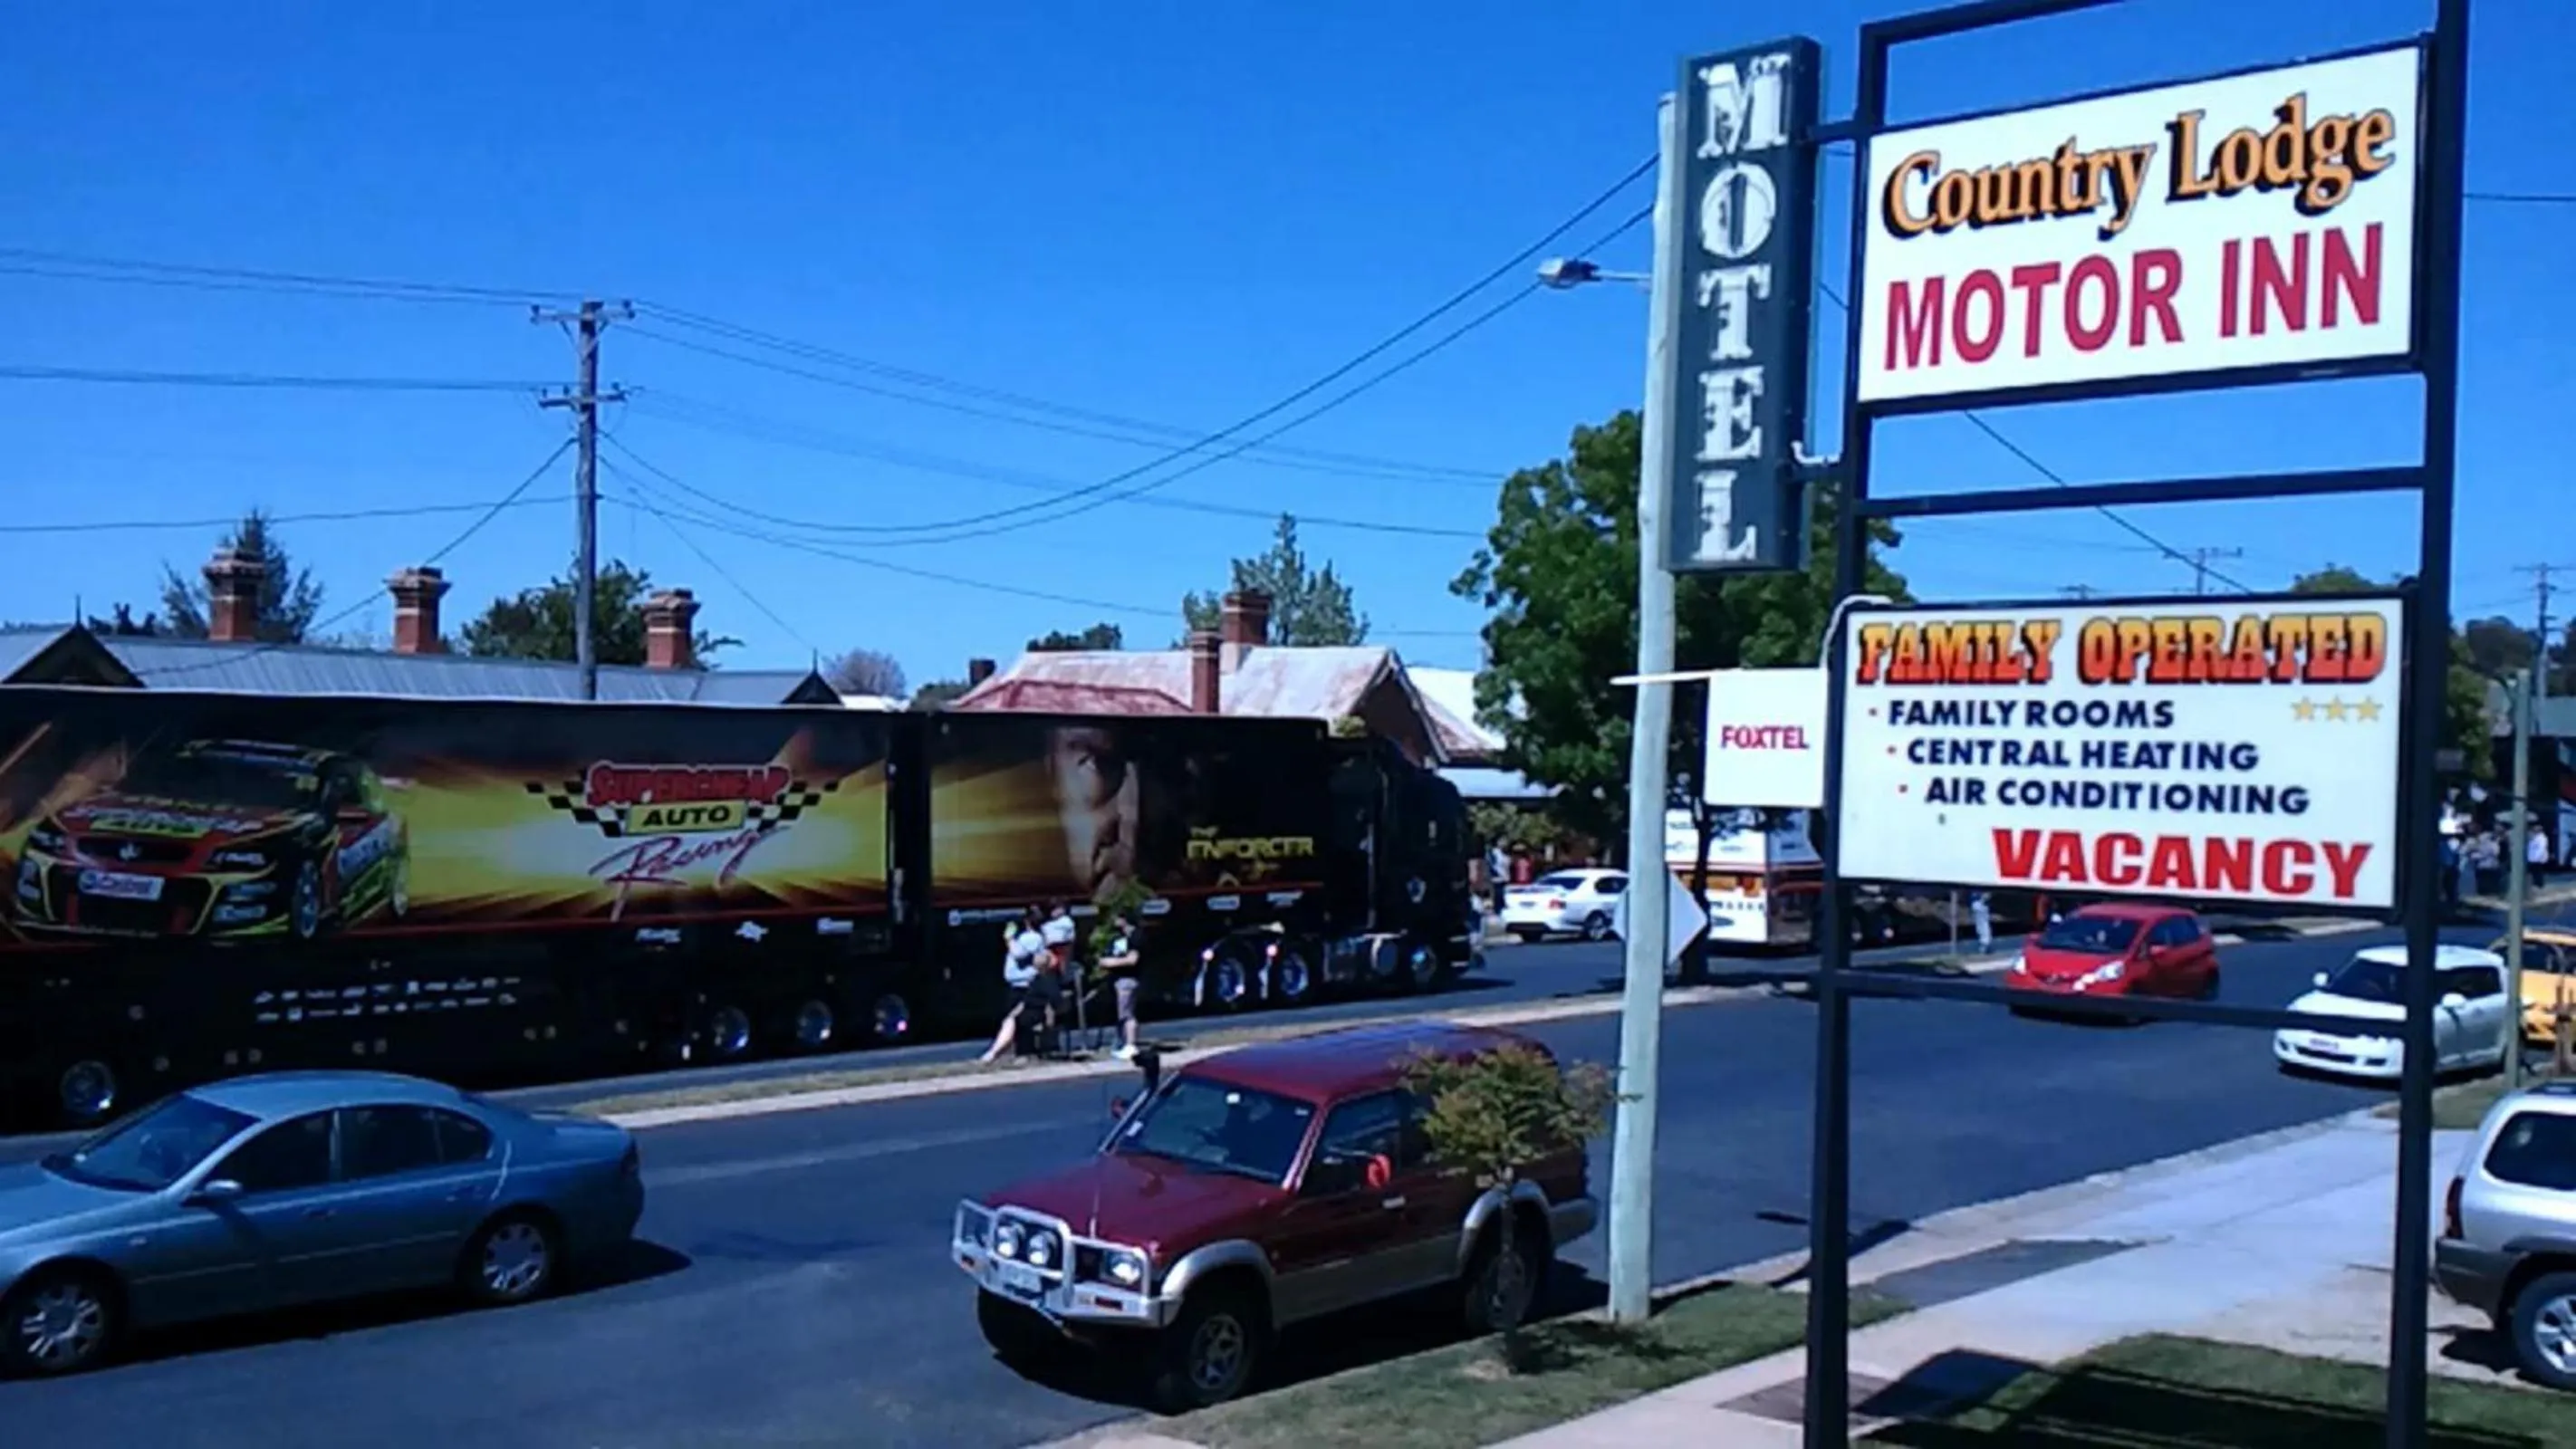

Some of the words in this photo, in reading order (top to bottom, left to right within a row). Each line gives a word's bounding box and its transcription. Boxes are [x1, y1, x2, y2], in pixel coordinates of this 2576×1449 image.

[1882, 138, 2156, 241] Country
[2166, 93, 2396, 215] Lodge
[1695, 53, 1791, 562] MOTEL
[1885, 248, 2182, 370] MOTOR
[2219, 222, 2383, 339] INN
[1857, 619, 2061, 686] FAMILY
[2076, 613, 2387, 685] OPERATED
[1889, 699, 2019, 726] FAMILY
[2026, 700, 2174, 727] ROOMS
[1721, 725, 1809, 749] FOXTEL
[1907, 738, 2071, 769] CENTRAL
[2086, 741, 2259, 772] HEATING
[586, 760, 791, 806] SUPERCHEAP
[1924, 778, 1986, 805] AIR
[1997, 780, 2309, 814] CONDITIONING
[642, 805, 730, 827] AUTO
[1992, 828, 2373, 897] VACANCY
